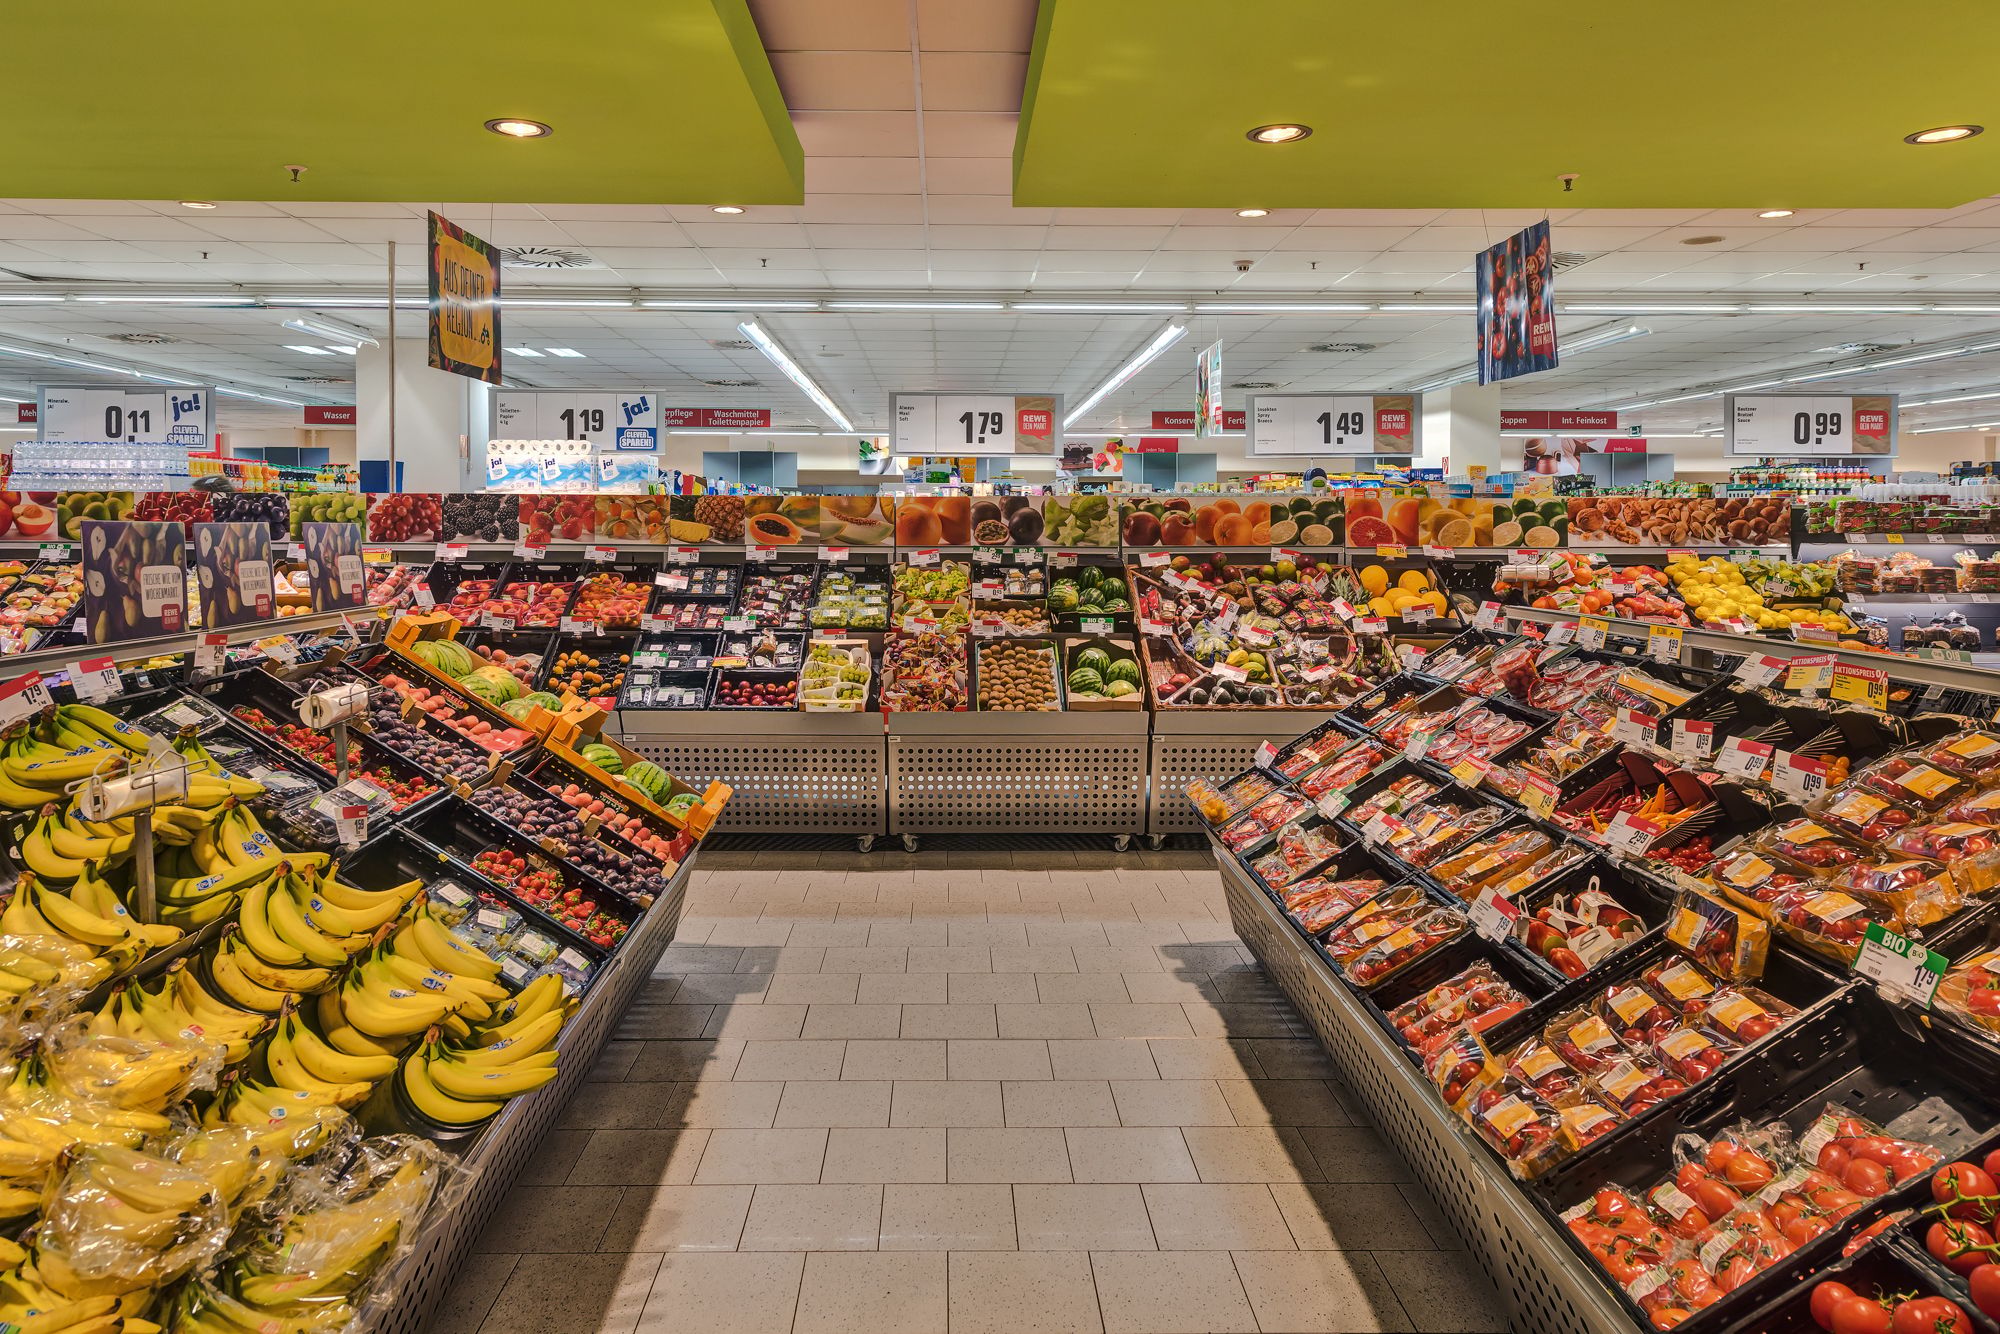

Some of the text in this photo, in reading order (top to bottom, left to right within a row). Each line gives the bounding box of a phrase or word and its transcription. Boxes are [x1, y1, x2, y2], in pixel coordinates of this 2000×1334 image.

[444, 258, 485, 304] AUS DEINER
[1534, 322, 1552, 335] REW
[171, 394, 200, 422] ja!
[622, 396, 650, 426] ja!
[105, 406, 150, 442] 0.11
[559, 408, 604, 440] 1.19
[708, 418, 764, 427] Toilettenpapier
[1023, 414, 1047, 423] REWE
[1500, 417, 1527, 425] Suppen
[959, 412, 1003, 444] 1.79
[1316, 412, 1363, 444] 1.49
[1794, 412, 1841, 444] 0.99
[168, 434, 203, 445] SPAREN!
[622, 438, 652, 446] SPAREN!
[491, 458, 502, 468] ja!
[545, 458, 555, 469] ja!
[603, 459, 613, 469] ja!
[143, 573, 160, 585] FRISCHE
[1792, 655, 1827, 665] AKTIONSPREIS
[100, 669, 114, 685] 1.79
[1819, 667, 1833, 681] 0.99
[1835, 666, 1888, 685] AKTIONSPREIS %
[21, 684, 42, 705] 1.79
[1868, 682, 1883, 699] 0.99
[1641, 727, 1653, 742] 0.99
[1696, 734, 1709, 749] 0.99
[1744, 756, 1764, 771] 0.99
[1803, 773, 1821, 792] 0.99
[1628, 831, 1648, 845] 2.99
[1882, 931, 1907, 953] BIO
[1913, 964, 1936, 988] 1.79
